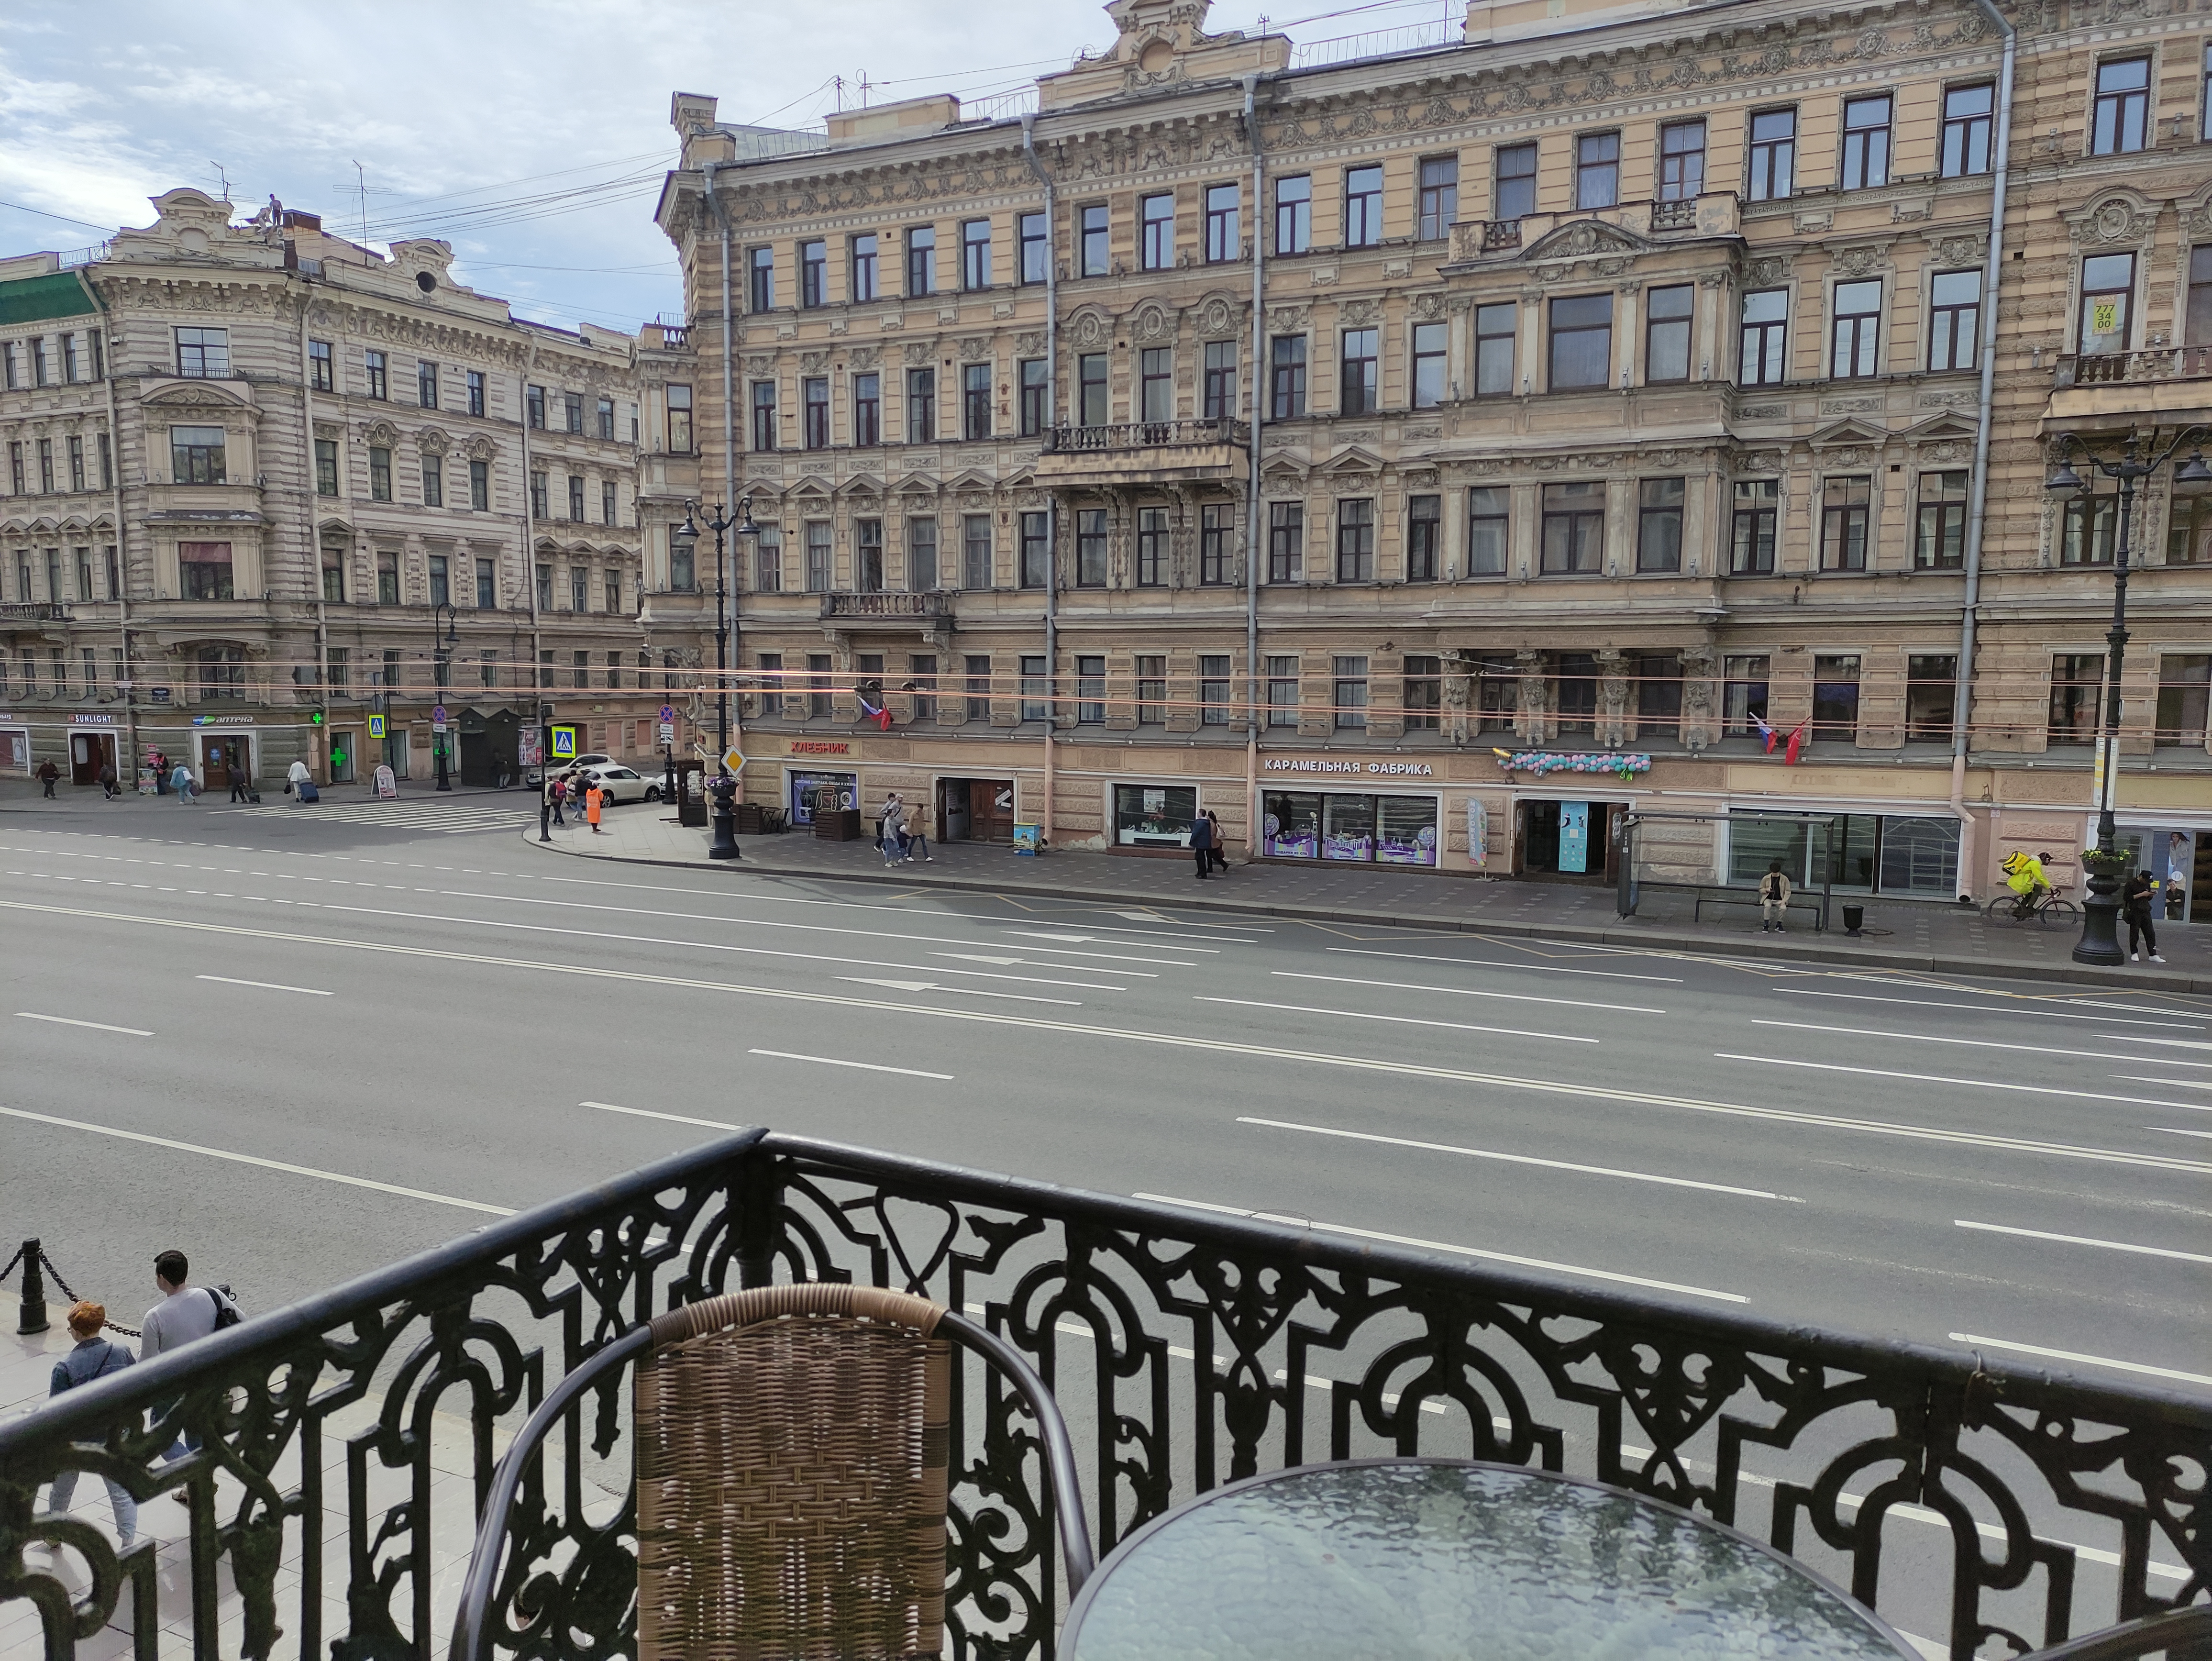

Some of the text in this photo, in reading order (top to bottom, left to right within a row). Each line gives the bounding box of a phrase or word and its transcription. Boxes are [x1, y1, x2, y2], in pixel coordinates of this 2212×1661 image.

[2096, 304, 2115, 313] 777
[2098, 312, 2111, 321] 34
[2098, 320, 2111, 328] 00
[791, 742, 850, 754] ХЛЕБНИК
[1264, 759, 1433, 775] КАРАМЕЛЬНАЯ ФАБРИКА
